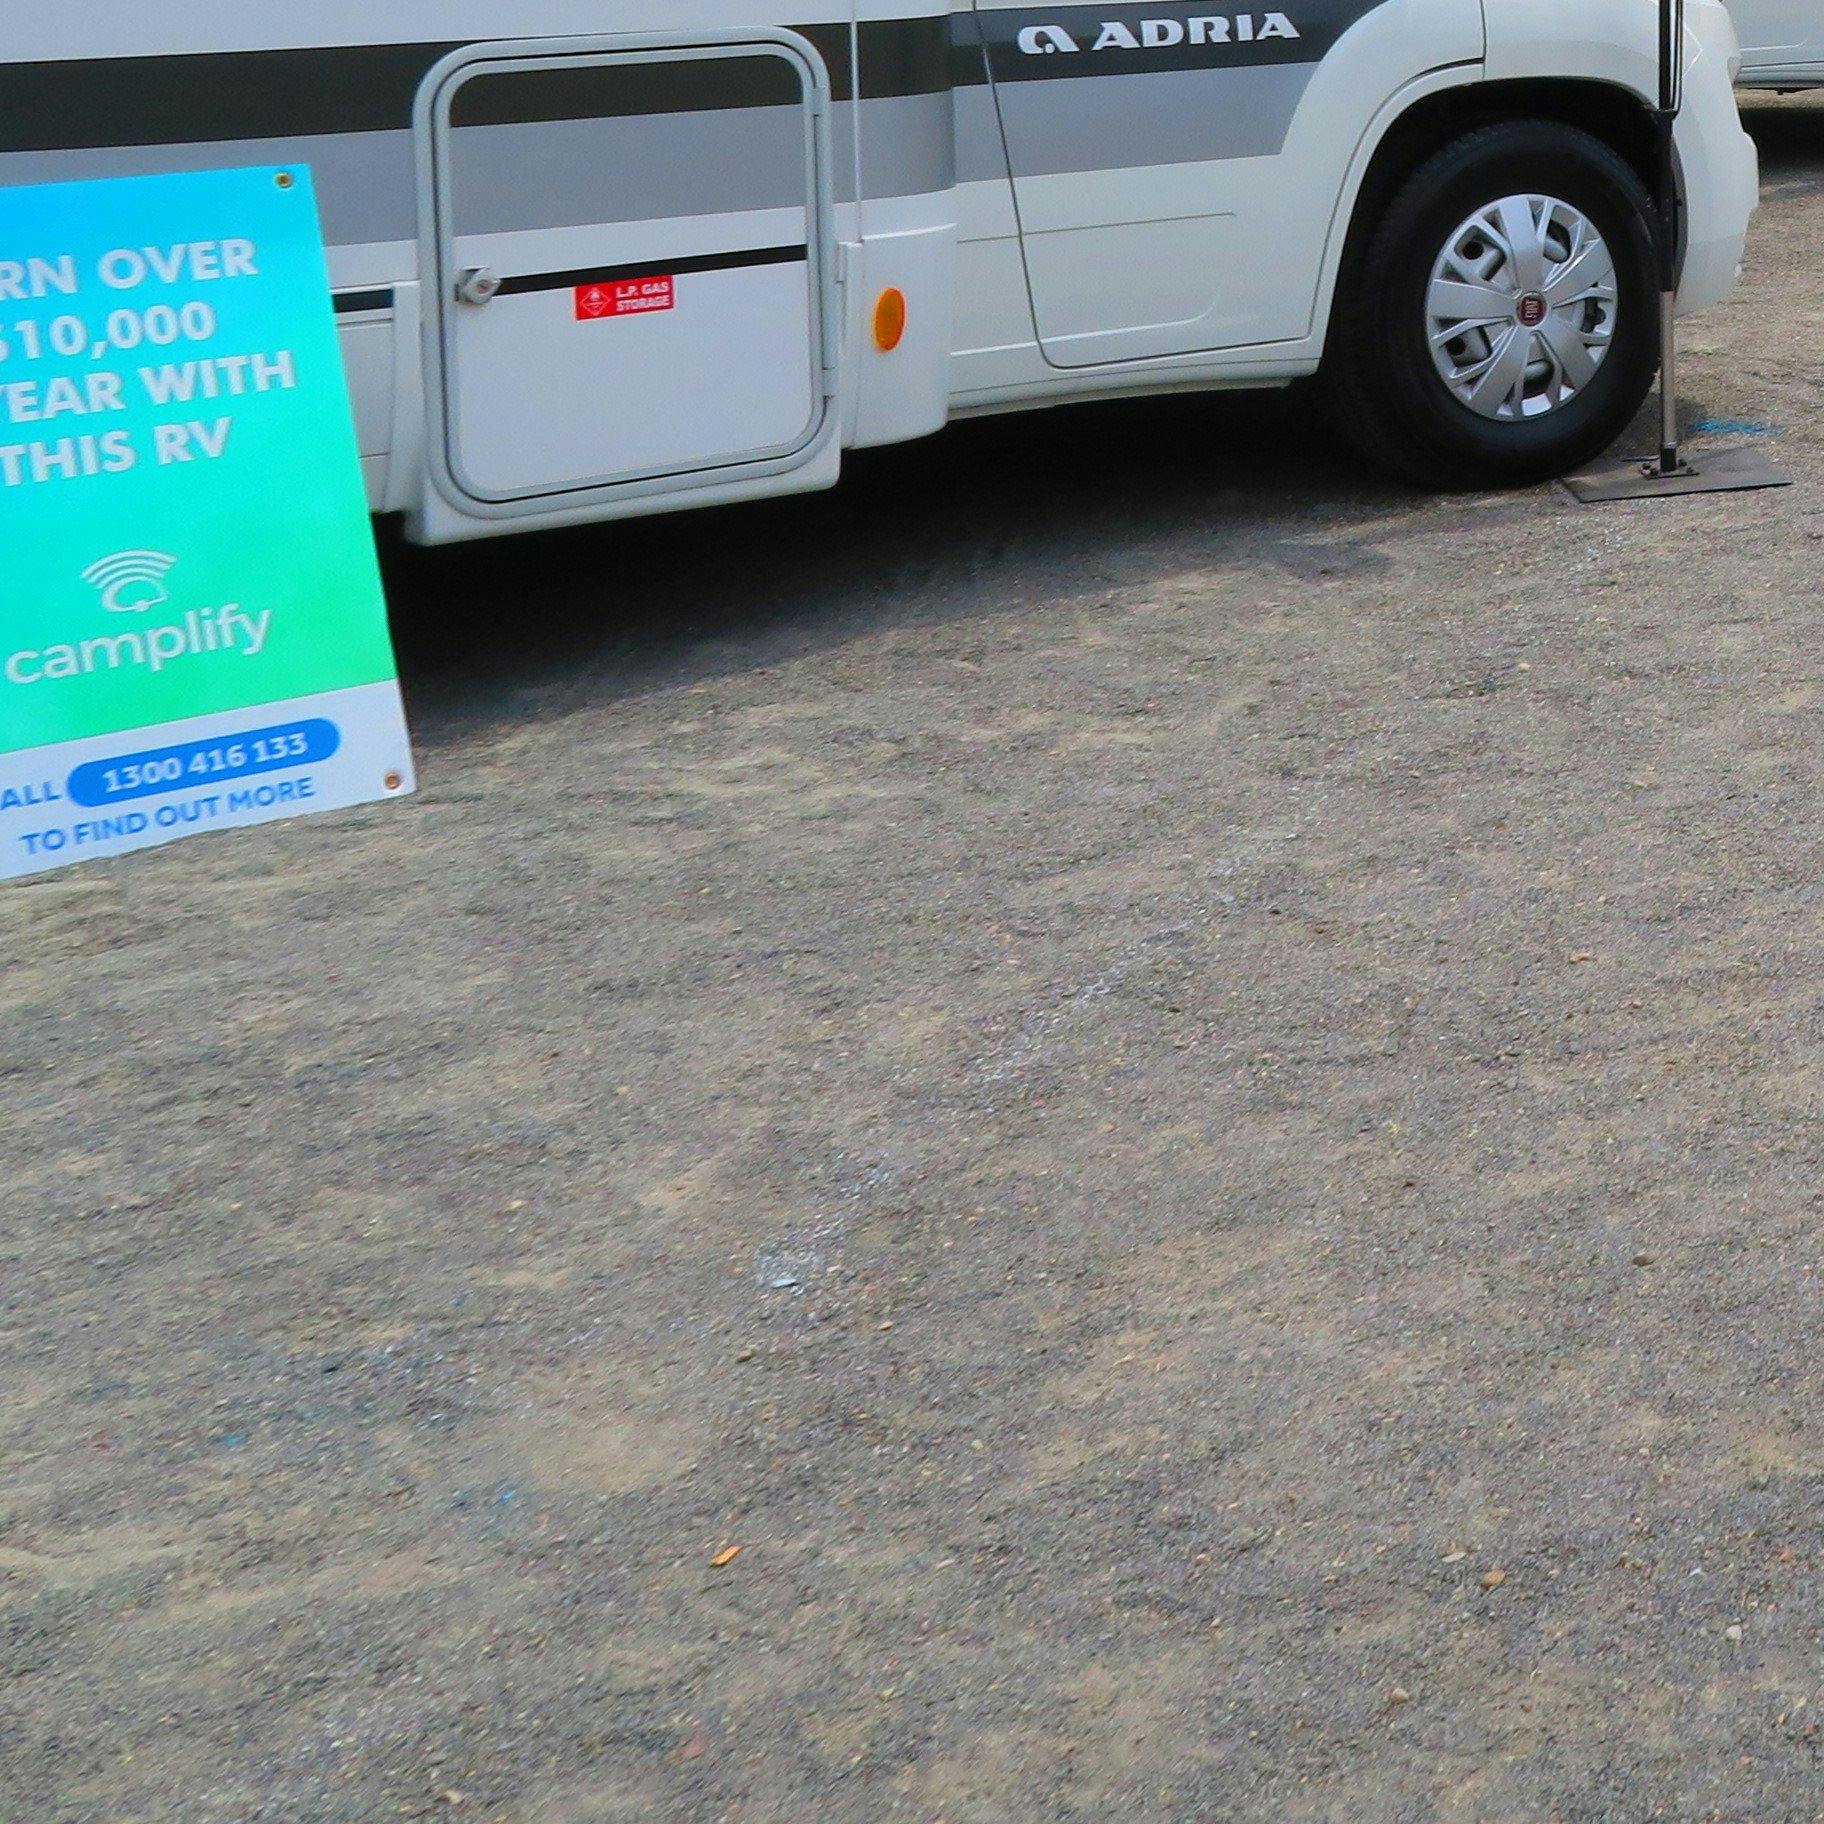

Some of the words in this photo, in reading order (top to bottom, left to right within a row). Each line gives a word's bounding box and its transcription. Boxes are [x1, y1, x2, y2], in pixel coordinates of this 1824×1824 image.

[1091, 12, 1300, 51] ADRIA
[99, 238, 259, 289] OVER
[641, 281, 670, 295] GAS
[0, 372, 127, 424] EAR
[137, 350, 297, 405] WITH
[0, 430, 136, 487] THIS
[154, 416, 233, 465] RV
[5, 602, 273, 684] camplify
[102, 757, 183, 793] 1300
[188, 744, 247, 776] 416
[252, 732, 308, 763] 133
[20, 828, 66, 856] TO
[74, 812, 147, 845] FIND
[154, 795, 220, 828] OUT
[227, 776, 316, 813] MORE
